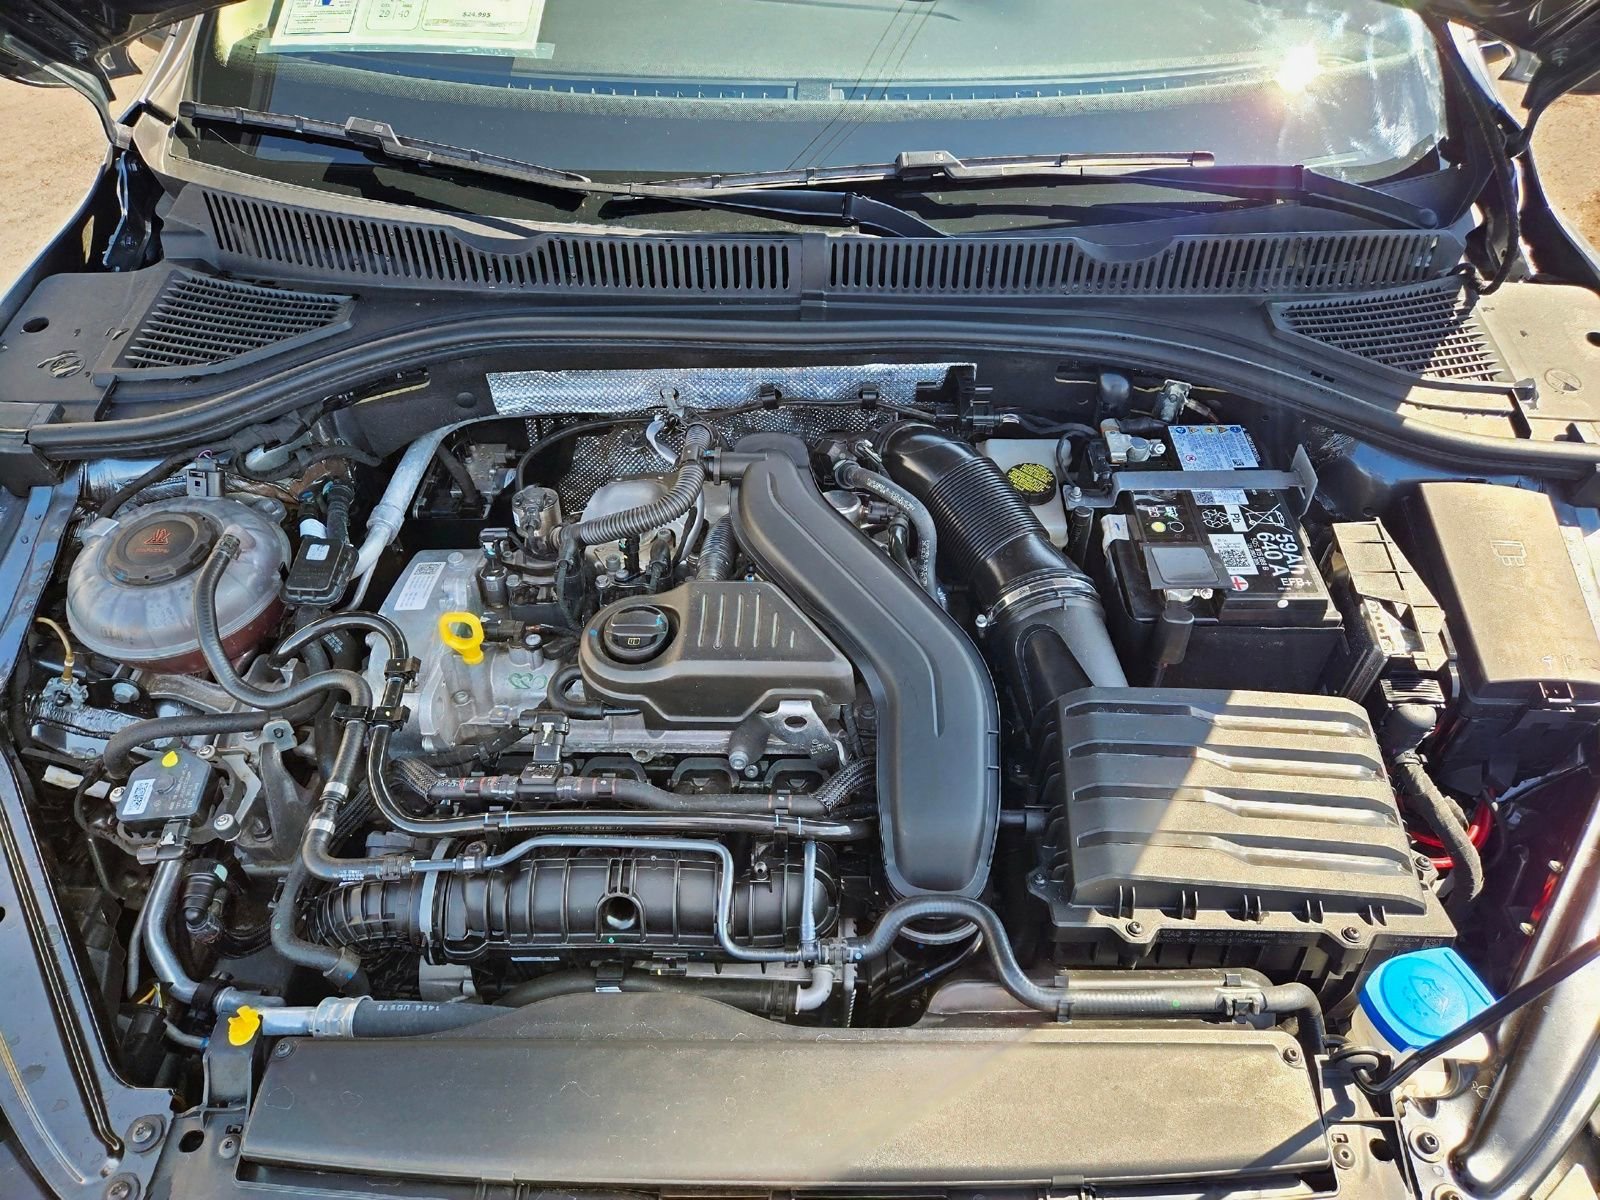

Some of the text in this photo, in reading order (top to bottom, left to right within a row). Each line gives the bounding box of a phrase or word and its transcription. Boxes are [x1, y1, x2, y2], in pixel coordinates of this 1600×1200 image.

[1230, 513, 1242, 523] Pb
[1256, 532, 1283, 560] 640
[1276, 533, 1308, 575] 59Ah
[1268, 563, 1290, 577] A
[1280, 577, 1312, 587] EFB+
